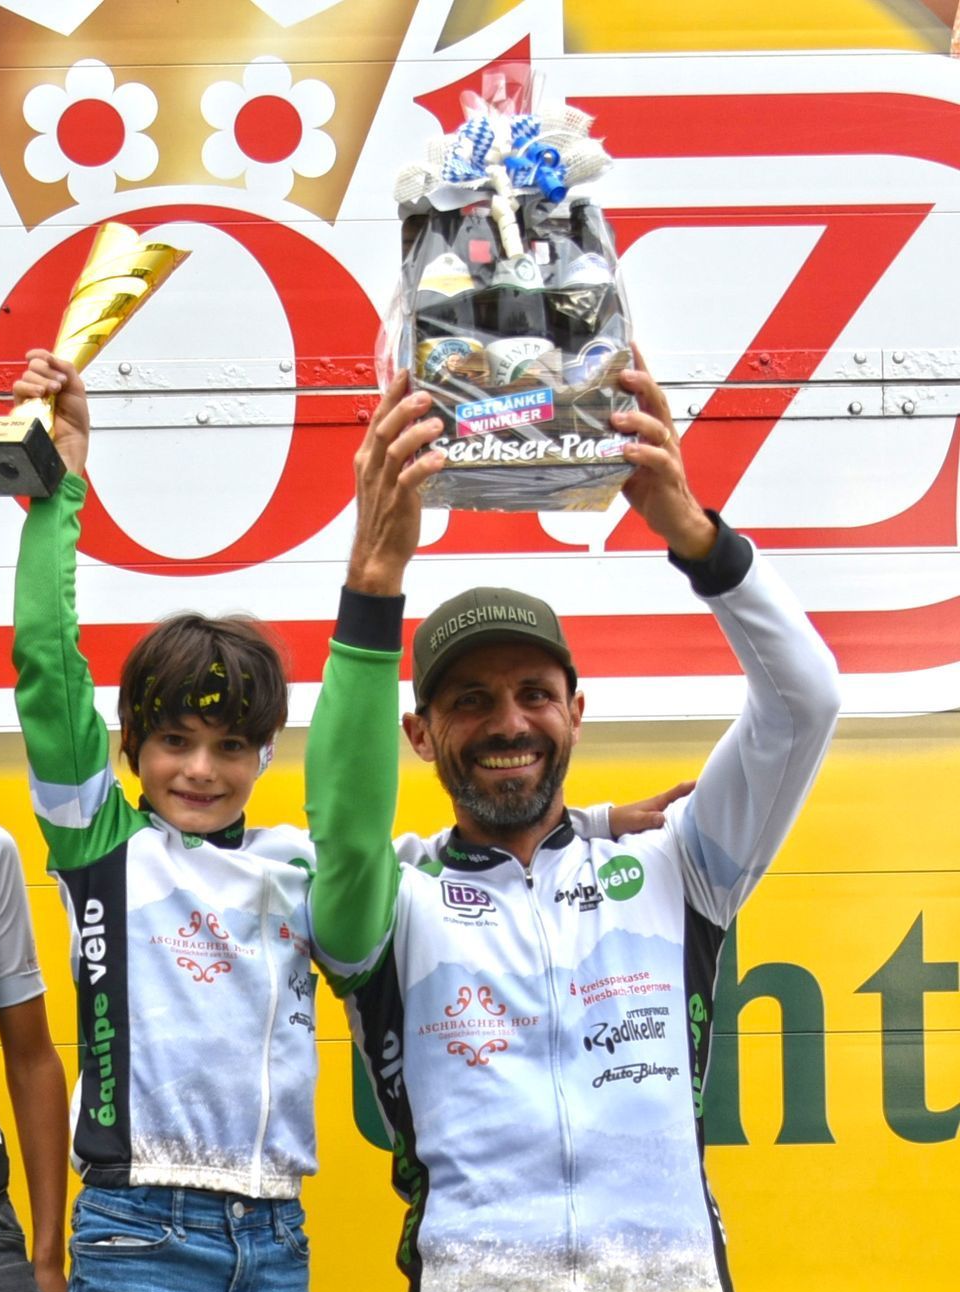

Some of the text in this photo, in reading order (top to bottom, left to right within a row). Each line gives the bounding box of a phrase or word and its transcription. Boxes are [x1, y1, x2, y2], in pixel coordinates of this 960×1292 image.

[468, 409, 542, 433] WINKLER
[428, 605, 538, 652] #RIDESHIMANO
[600, 866, 642, 890] vélo
[450, 885, 488, 904] tbs
[79, 898, 108, 986] vélo
[149, 935, 230, 952] ASCHBACHER
[579, 971, 651, 995] Kreissparkasse
[626, 1006, 670, 1020] OTTERFINGER
[418, 1015, 540, 1036] ASCHBACHER HOF
[90, 992, 117, 1128] équipe
[591, 1062, 680, 1088] Auto-Biberger
